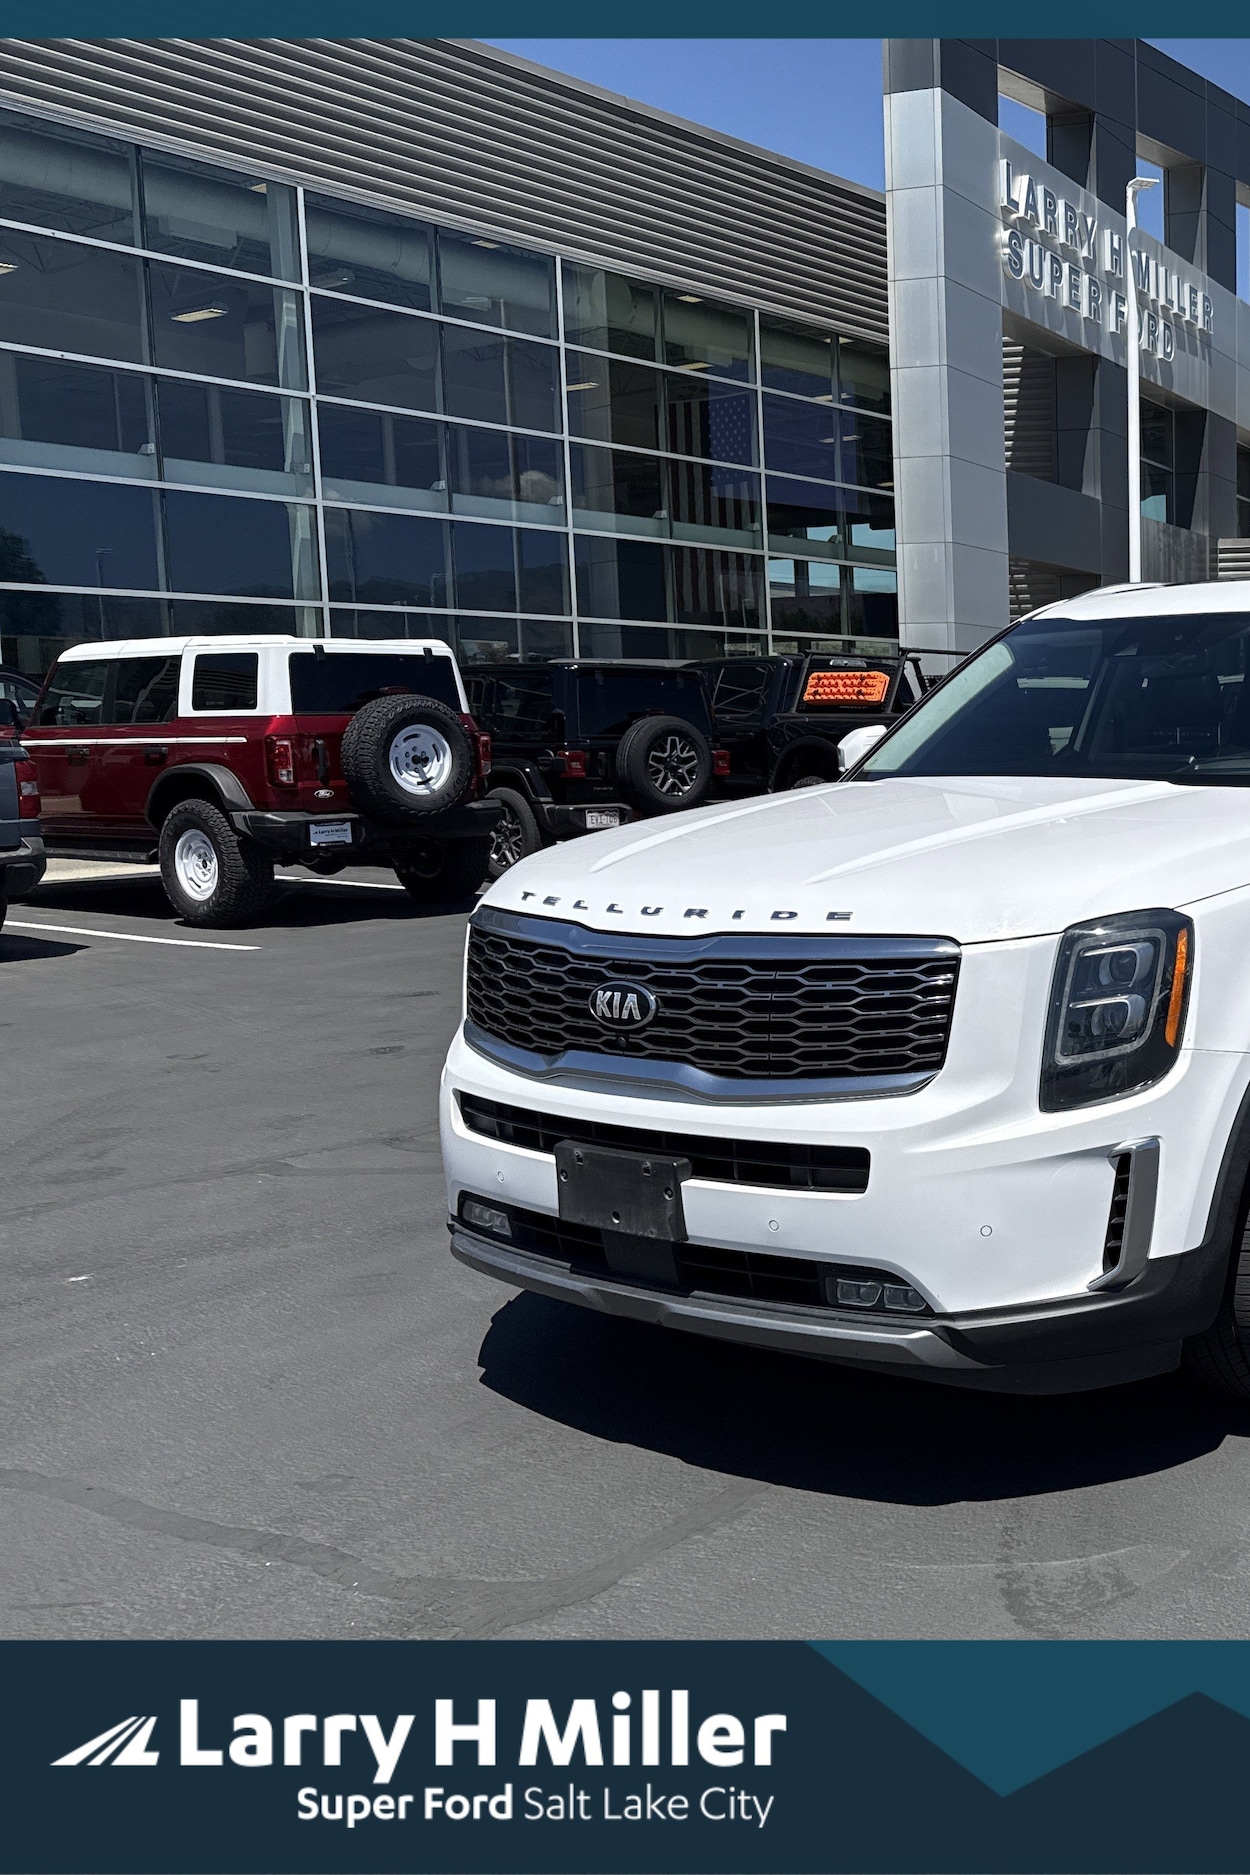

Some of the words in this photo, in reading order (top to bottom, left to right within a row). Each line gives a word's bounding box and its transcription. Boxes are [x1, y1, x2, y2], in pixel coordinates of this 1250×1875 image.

[1000, 159, 1097, 259] LARRY
[1104, 229, 1123, 278] H
[1133, 250, 1214, 334] MILLER
[1001, 229, 1102, 324] SUPER
[1110, 290, 1174, 361] FRD
[521, 890, 853, 921] TELLURIDE
[596, 990, 642, 1021] KIA
